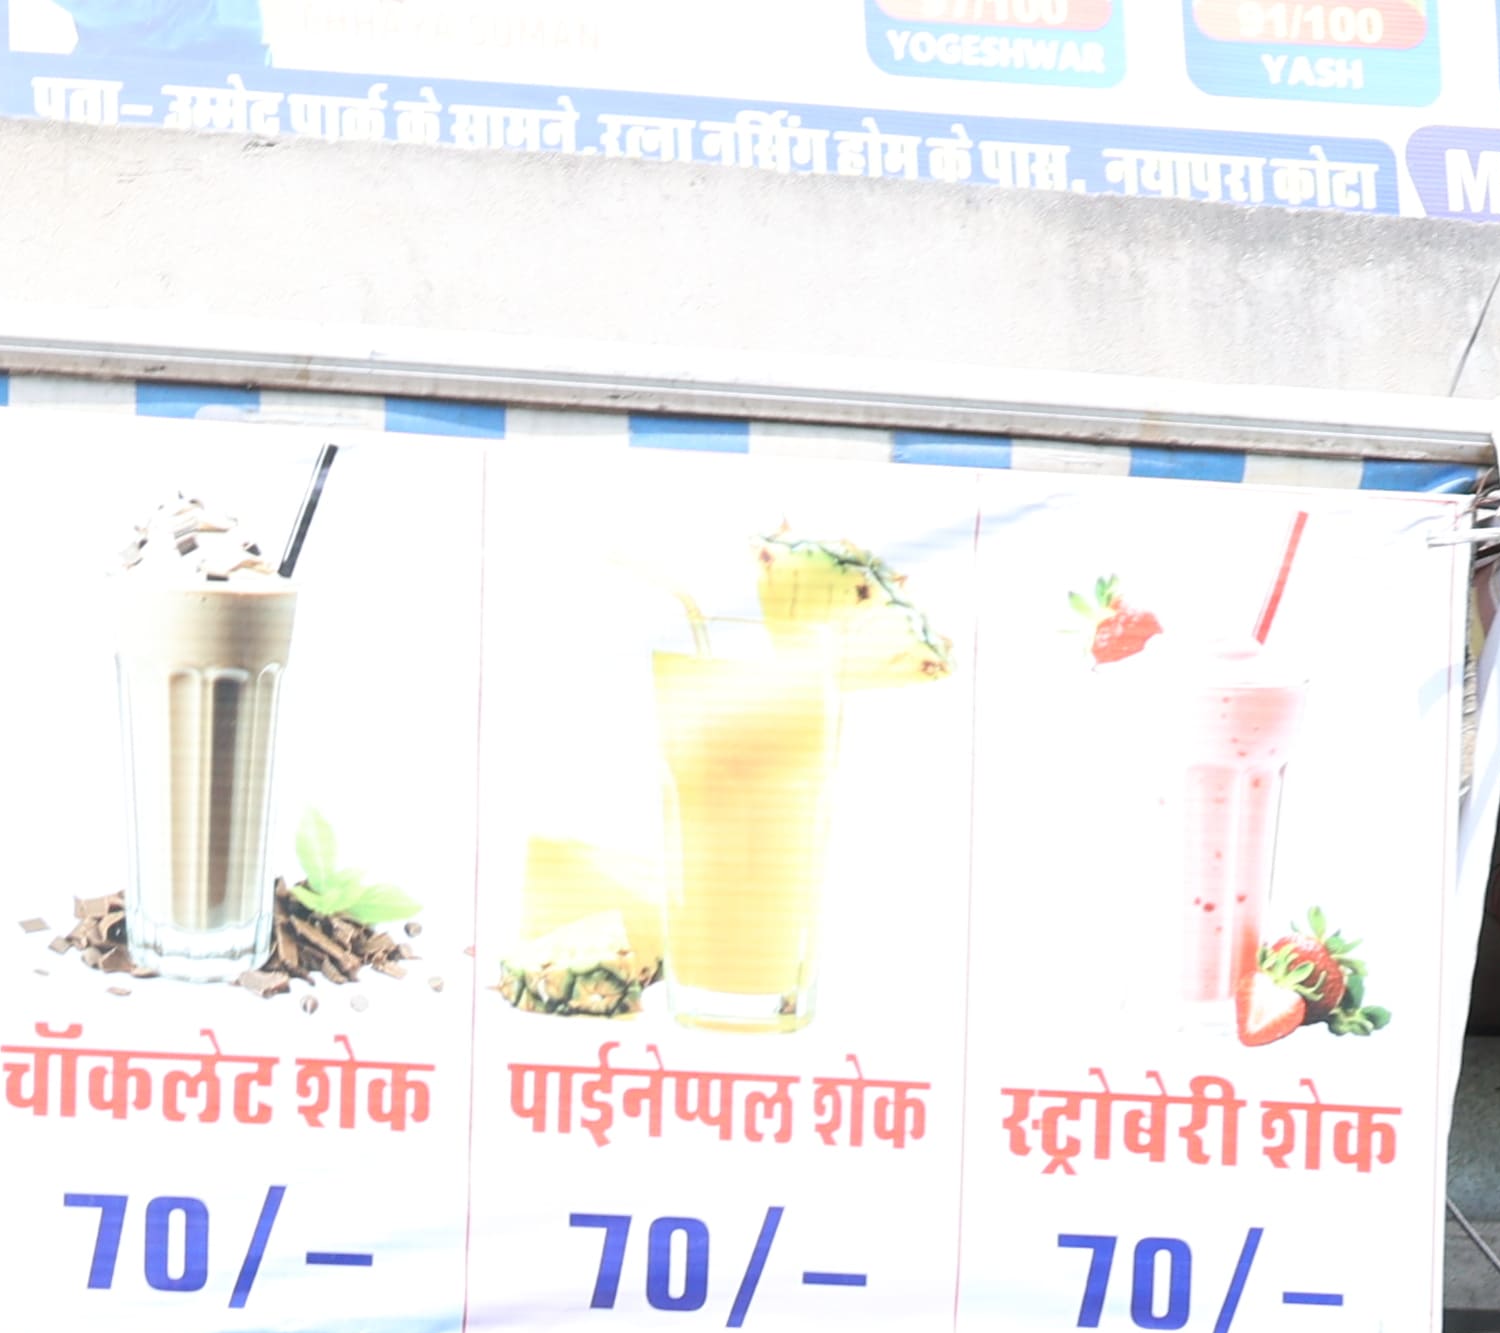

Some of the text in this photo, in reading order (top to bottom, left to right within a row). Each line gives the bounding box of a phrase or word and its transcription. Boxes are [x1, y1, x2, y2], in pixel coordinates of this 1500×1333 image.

[886, 28, 1106, 74] YOGESHWAR
[1260, 53, 1365, 90] YASH
[289, 82, 388, 145] पार्क
[395, 86, 441, 146] के
[835, 118, 921, 179] होम
[926, 124, 974, 184] के
[1271, 145, 1380, 210] कोटा
[0, 1021, 436, 1133] चॉकलेट शेक
[507, 1040, 931, 1151] पाईनेप्पल शेक
[1000, 1066, 1403, 1177] स्ट्रोबेरी शेक
